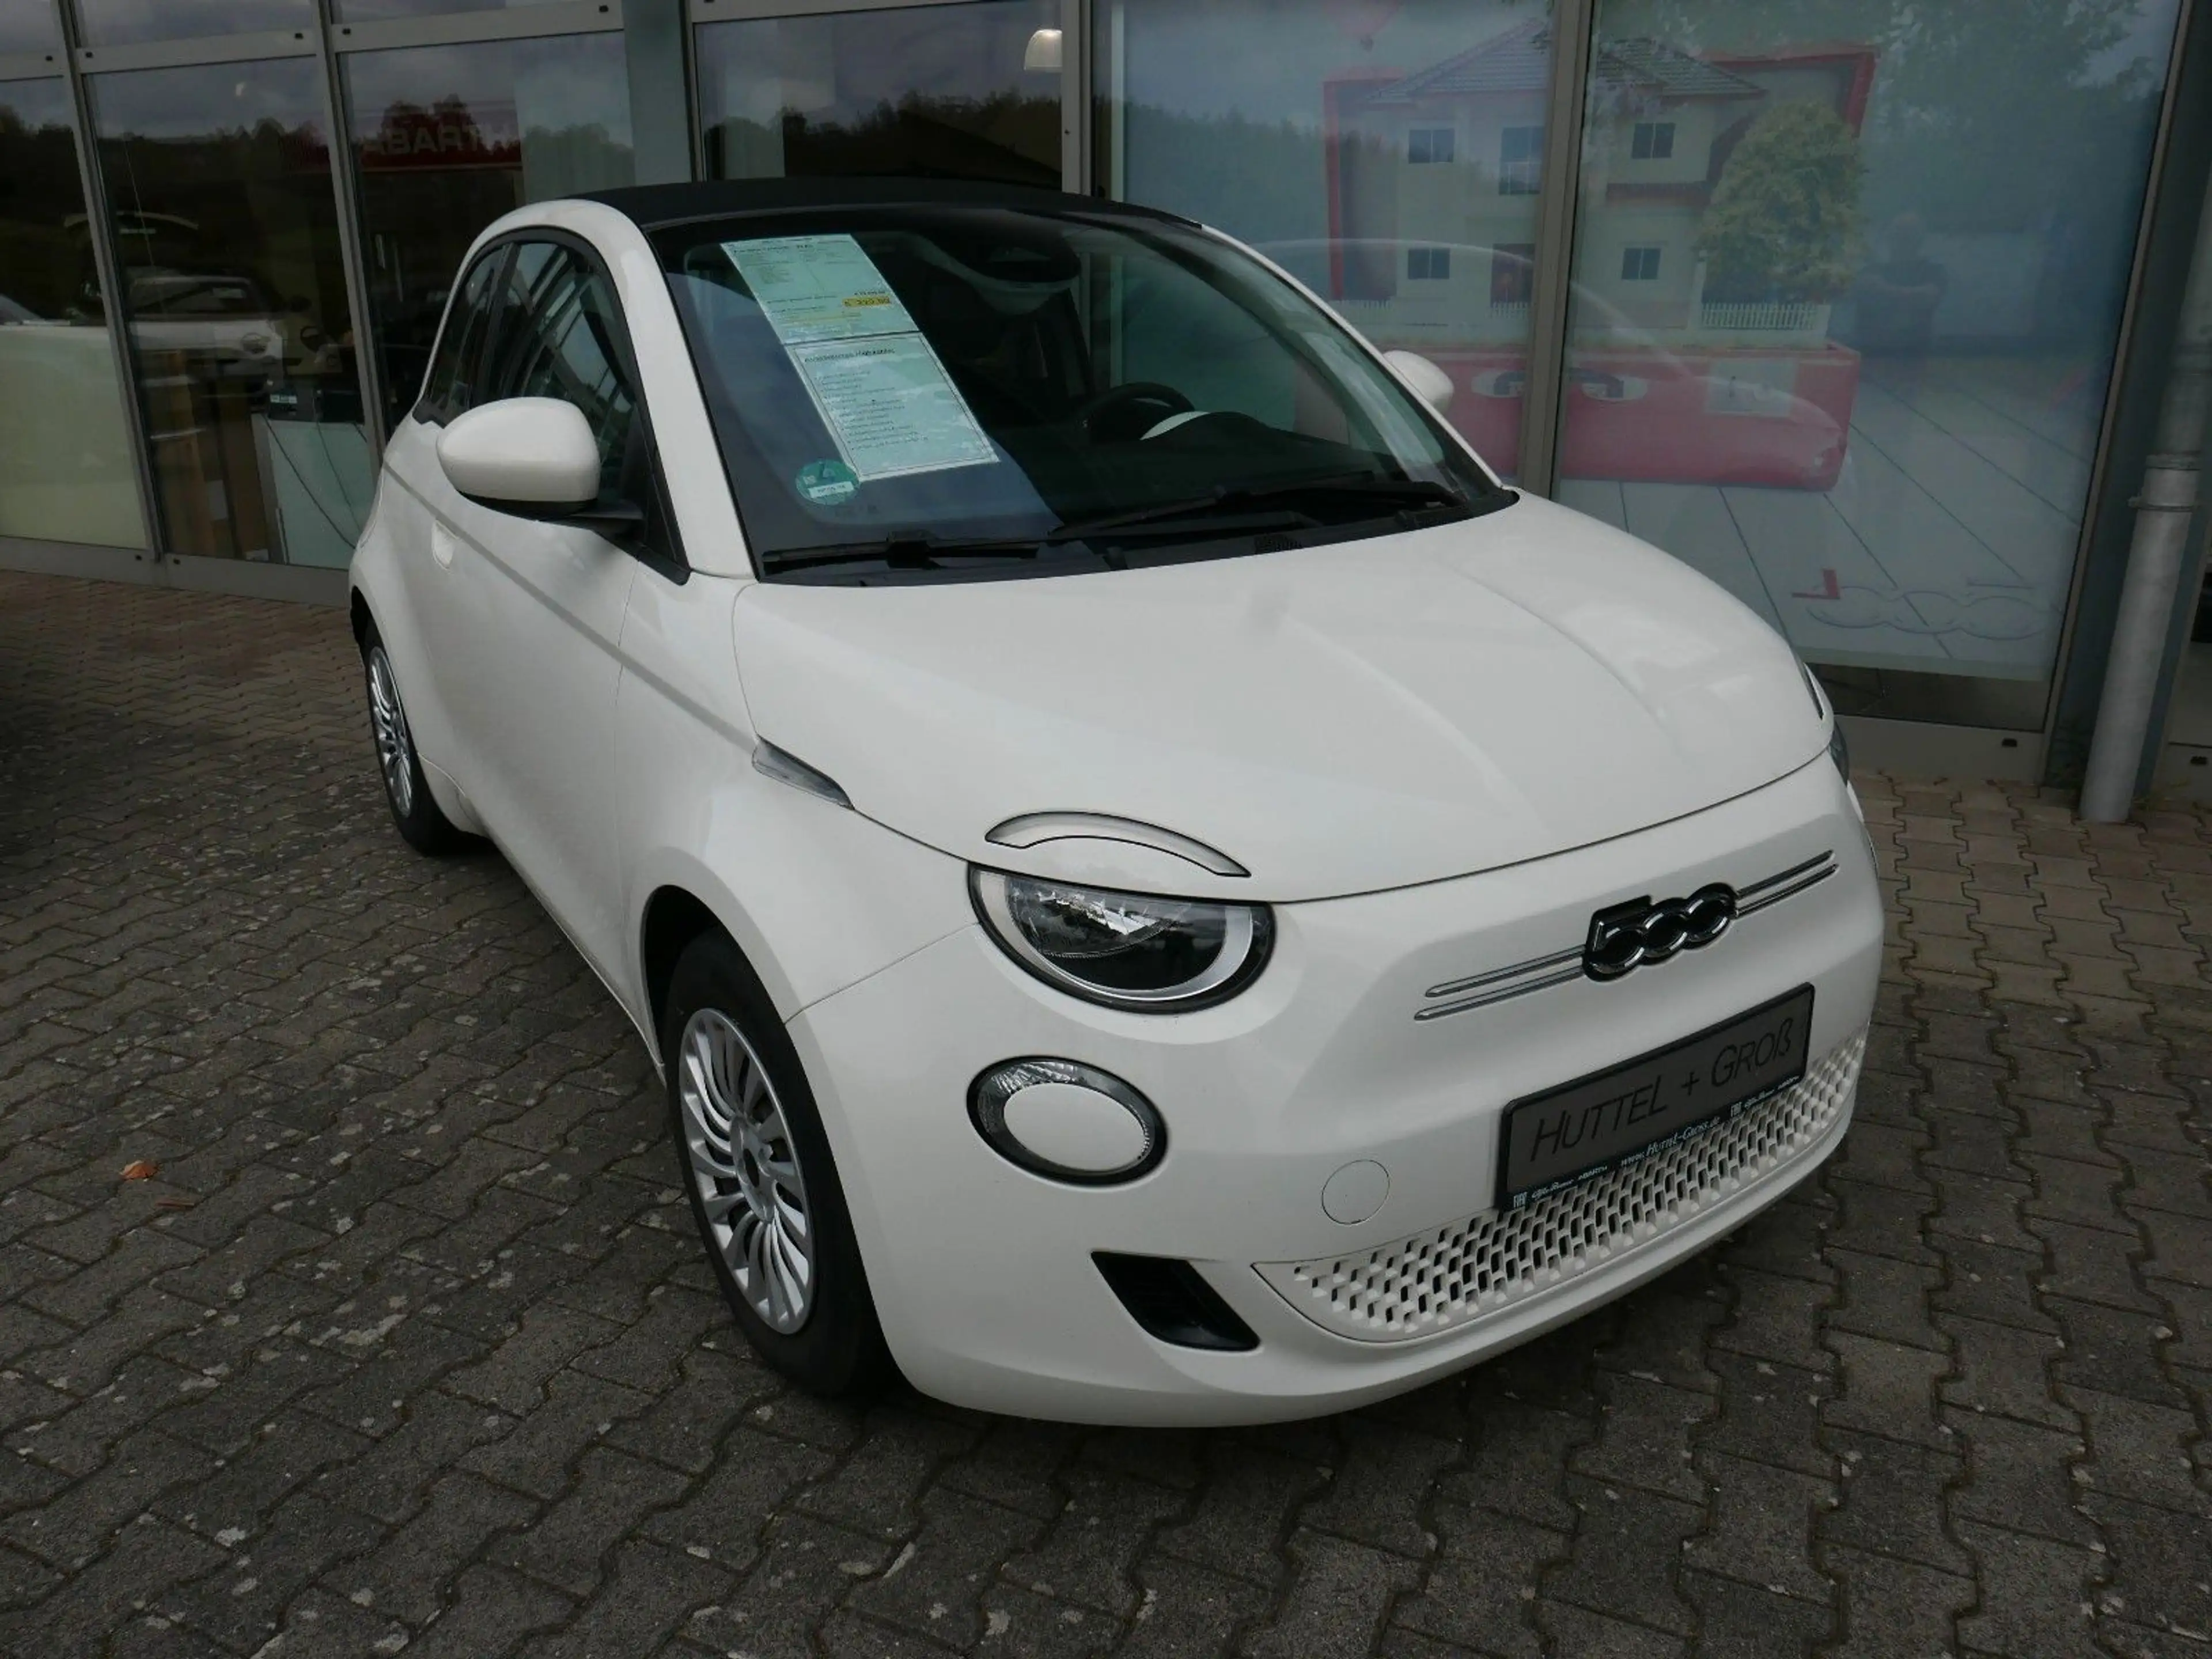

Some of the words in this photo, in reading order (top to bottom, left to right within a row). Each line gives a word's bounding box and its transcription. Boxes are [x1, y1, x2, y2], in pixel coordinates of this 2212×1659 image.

[362, 124, 517, 154] ABARTH
[1582, 882, 1737, 982] 500
[1530, 1075, 1668, 1162] HUTTEL
[1681, 1071, 1700, 1096] +
